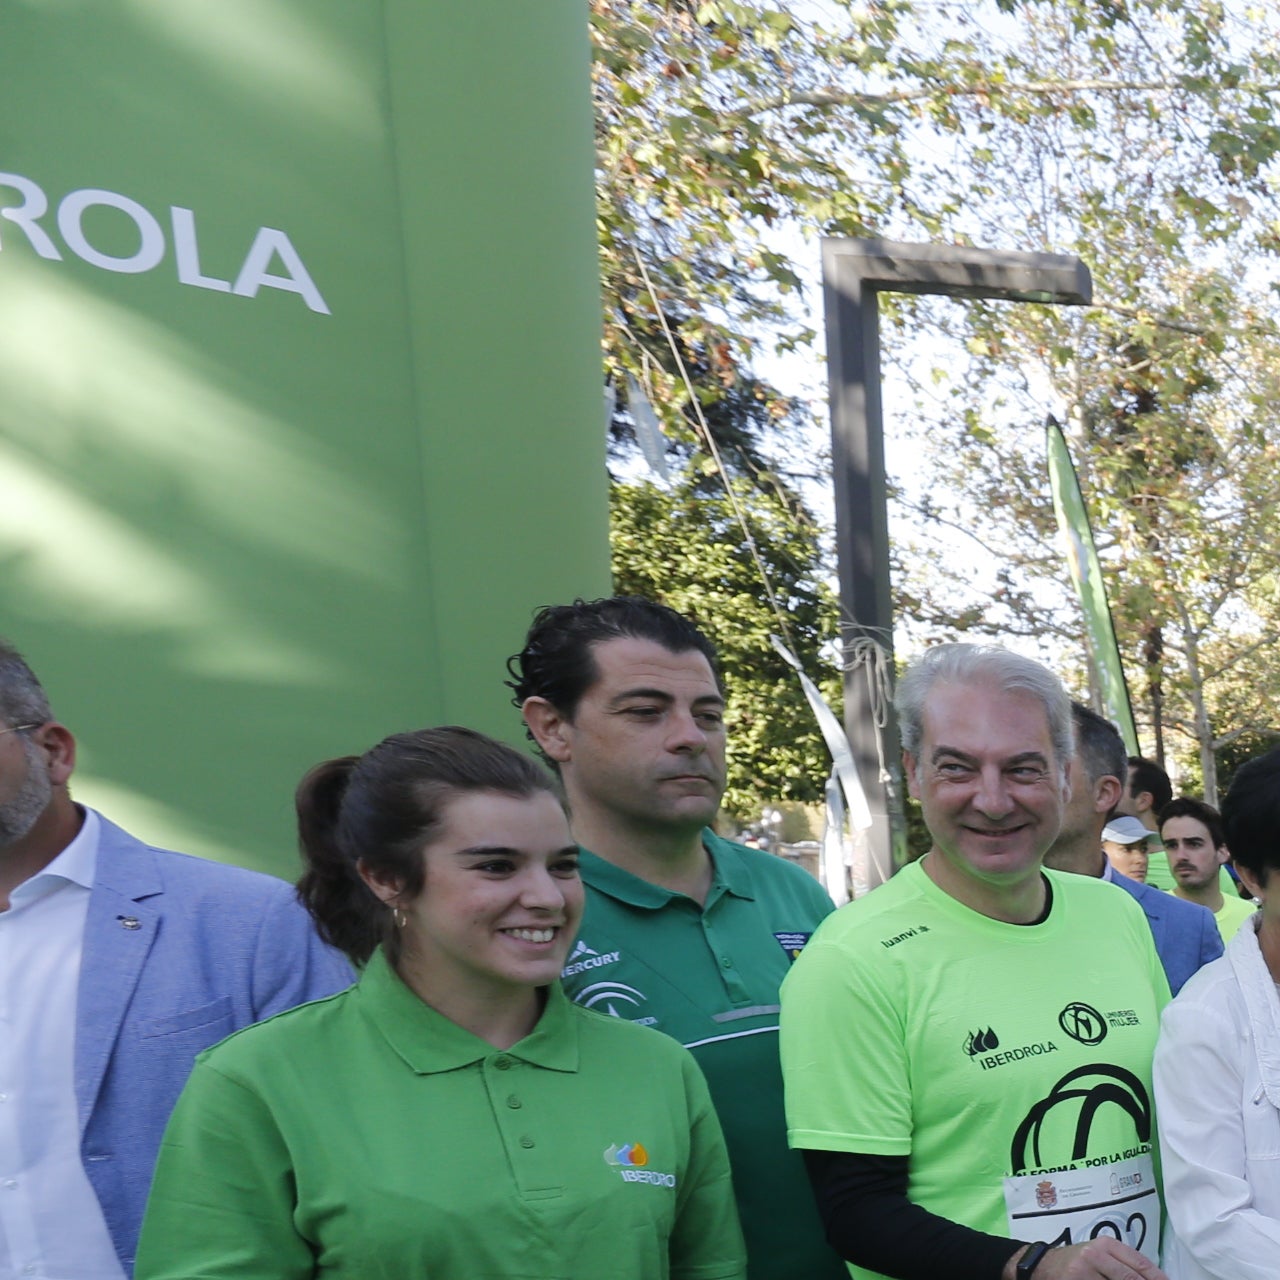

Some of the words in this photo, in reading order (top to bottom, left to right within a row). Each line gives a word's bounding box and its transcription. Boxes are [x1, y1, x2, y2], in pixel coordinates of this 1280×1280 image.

[881, 927, 918, 948] luanvi
[980, 1040, 1058, 1071] IBERDROLA
[1086, 1156, 1108, 1168] POR
[1109, 1153, 1121, 1163] LA
